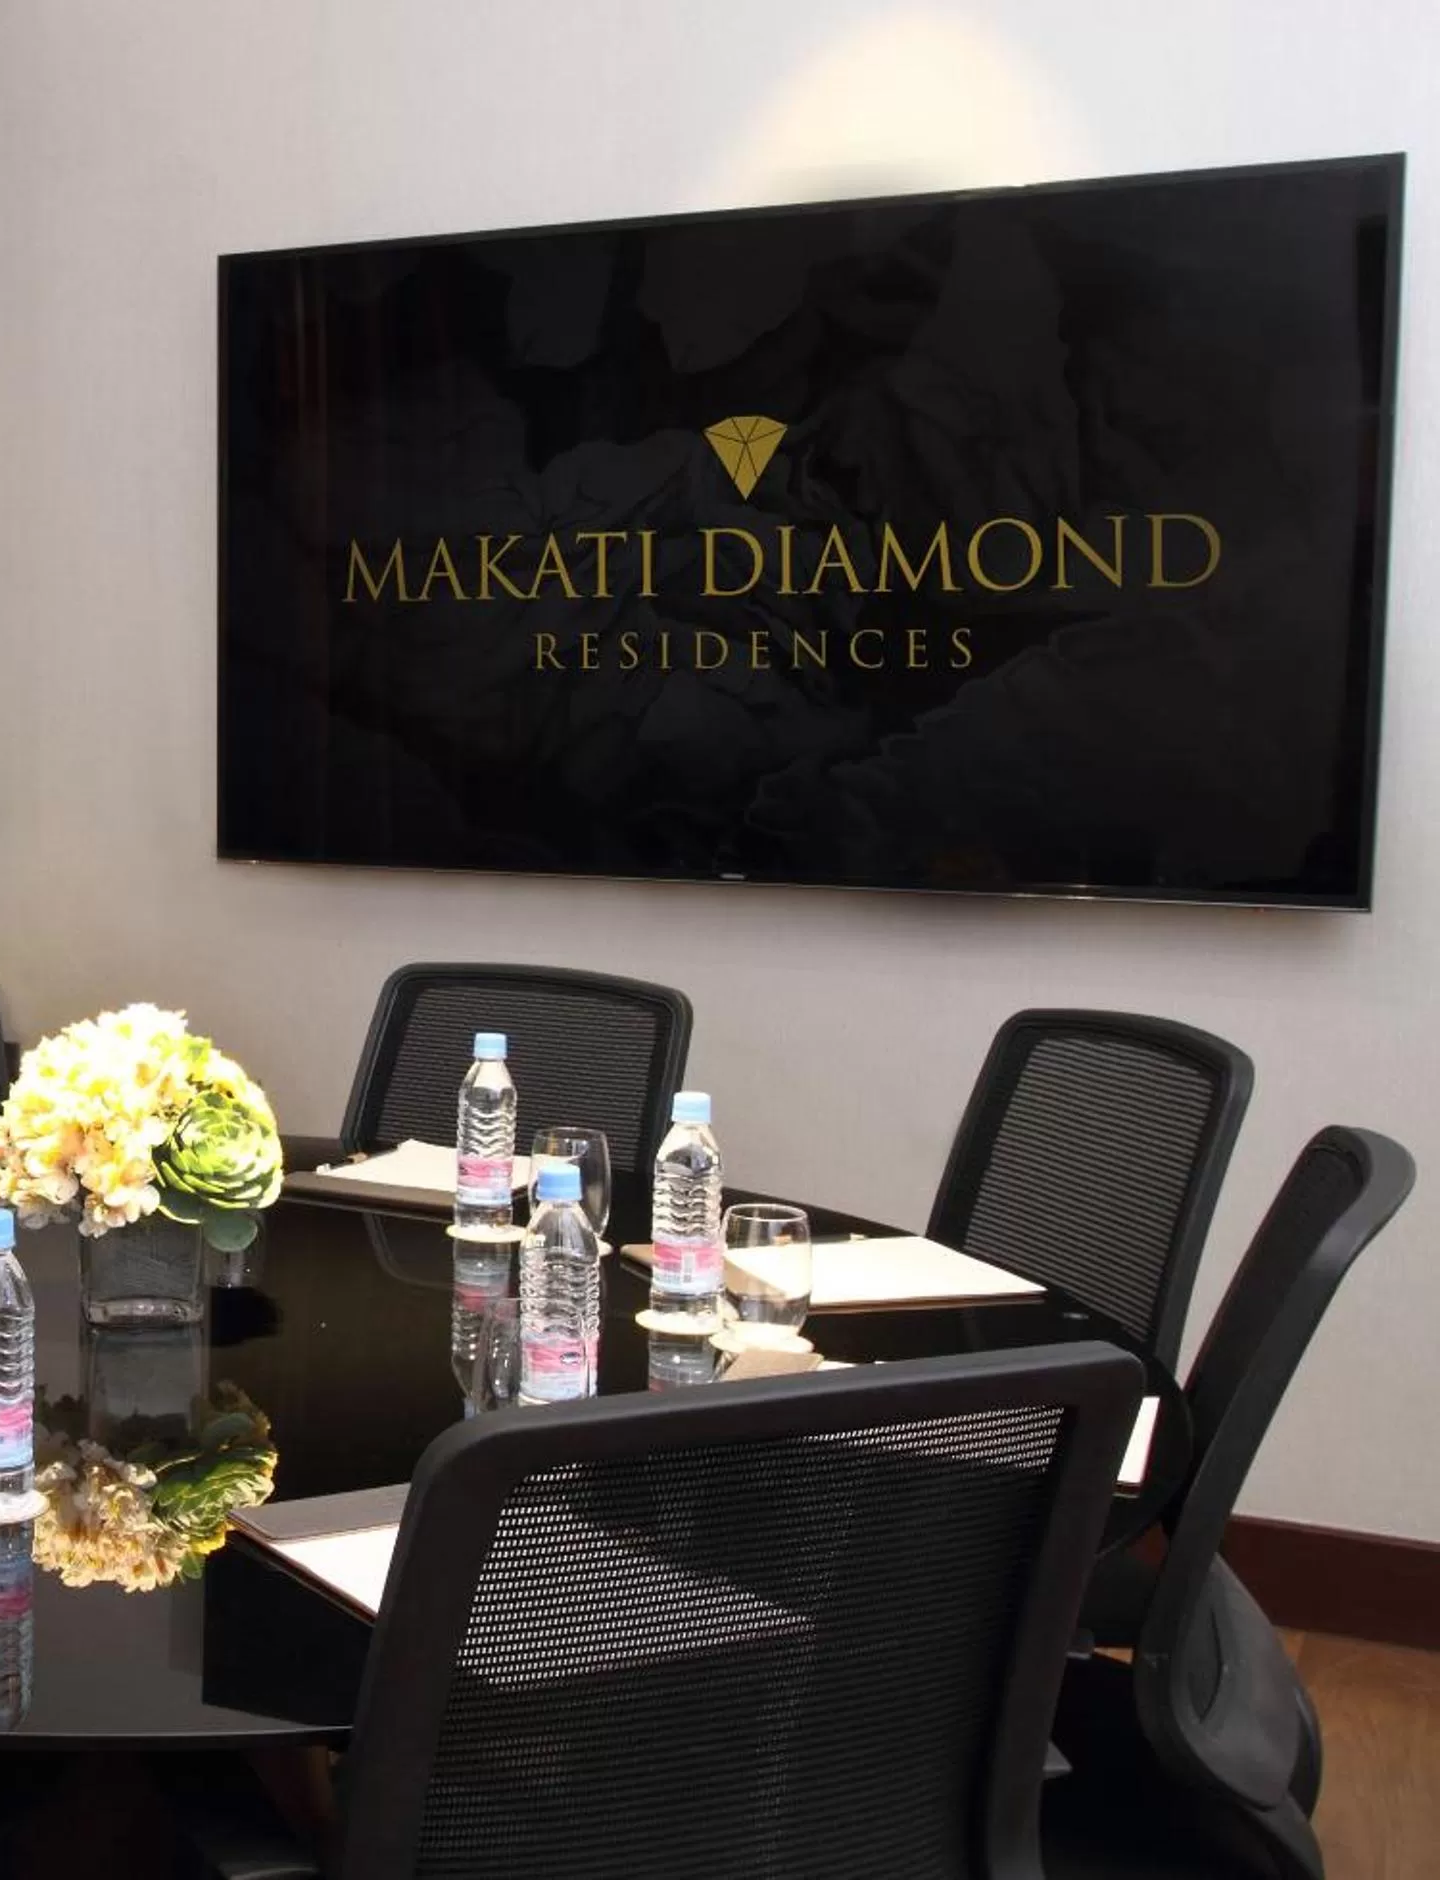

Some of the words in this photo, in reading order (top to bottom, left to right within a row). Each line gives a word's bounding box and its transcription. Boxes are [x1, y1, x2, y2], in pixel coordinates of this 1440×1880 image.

[343, 530, 658, 603] MAKATI
[700, 513, 1221, 597] DIAMOND
[534, 629, 974, 671] RESIDENCES
